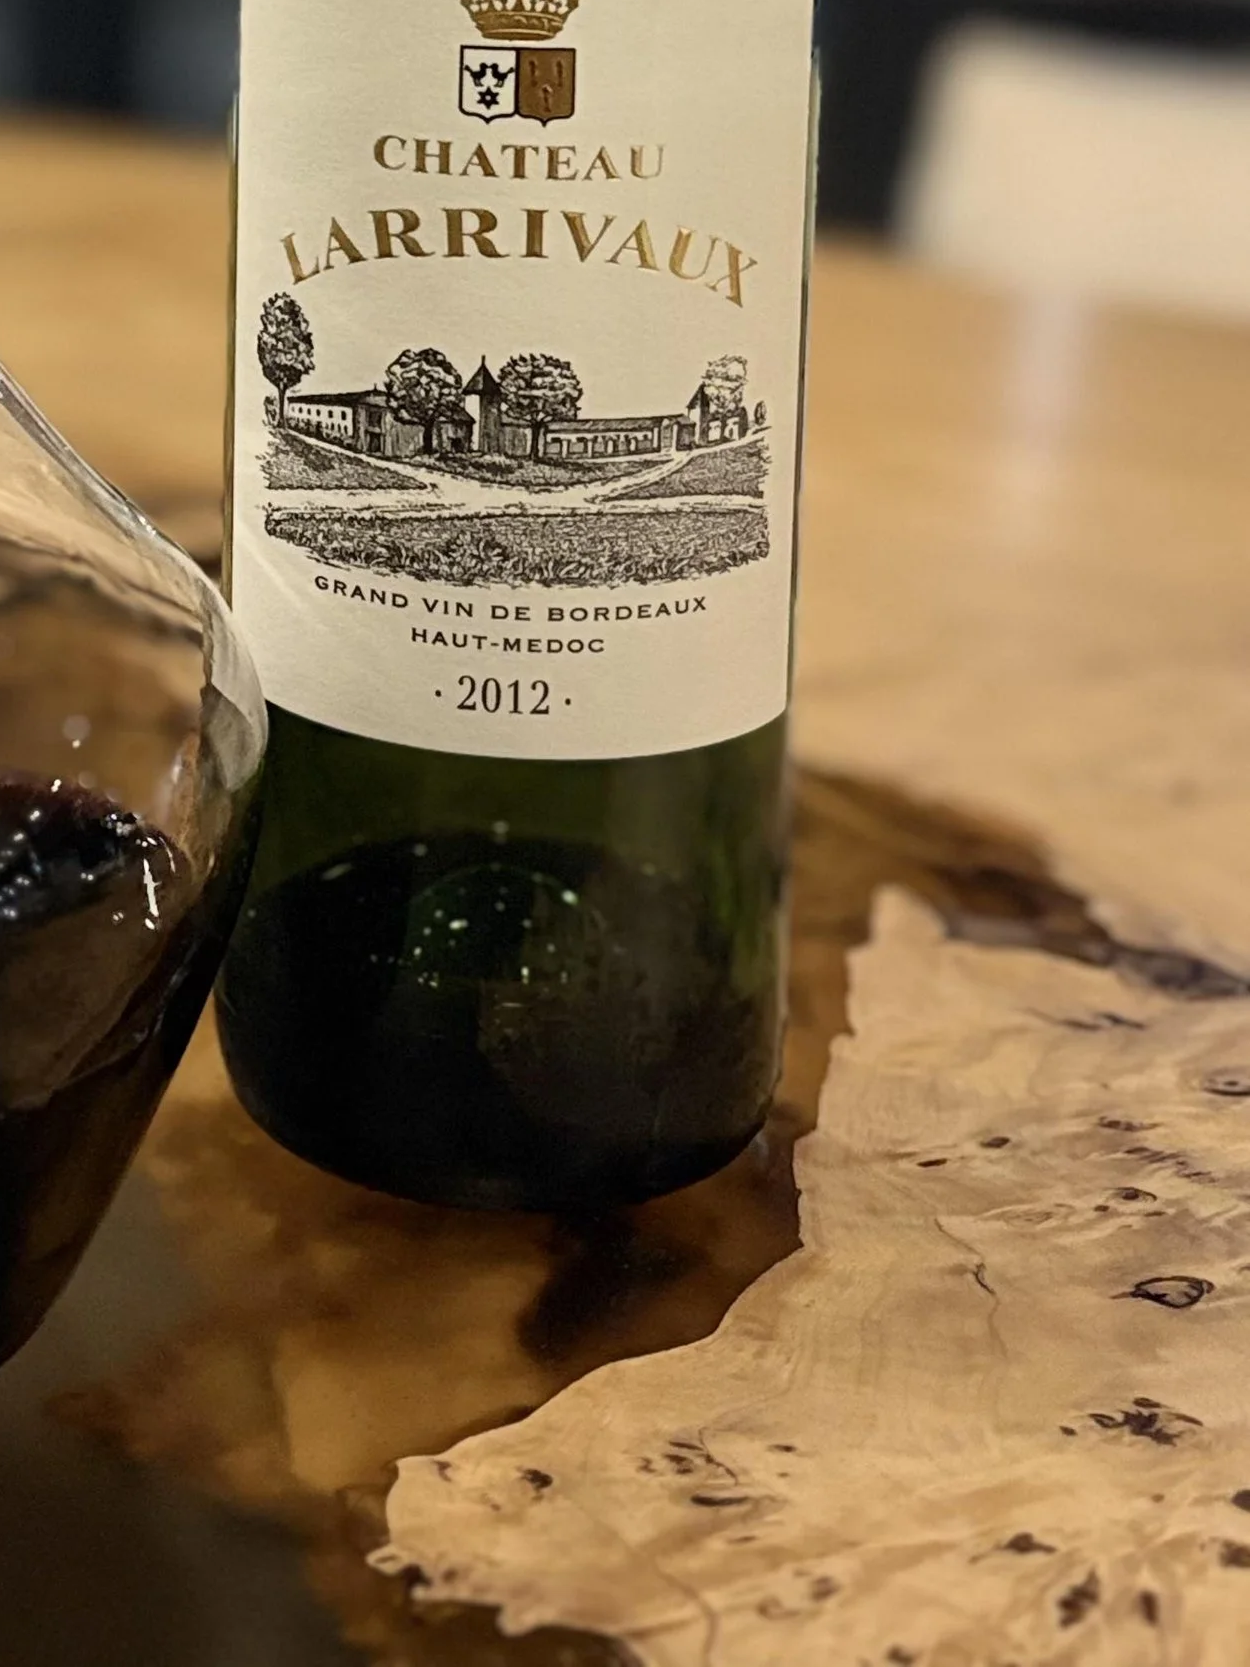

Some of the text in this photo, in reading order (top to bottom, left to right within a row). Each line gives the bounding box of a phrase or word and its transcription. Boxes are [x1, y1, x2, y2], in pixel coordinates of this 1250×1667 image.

[373, 134, 665, 182] CHATEAU
[280, 207, 758, 308] LARRIVAUX
[314, 575, 707, 623] GRAND VIN DE BORDEAUX
[411, 627, 605, 654] HAUT-MEDOC
[456, 674, 551, 715] 2012
